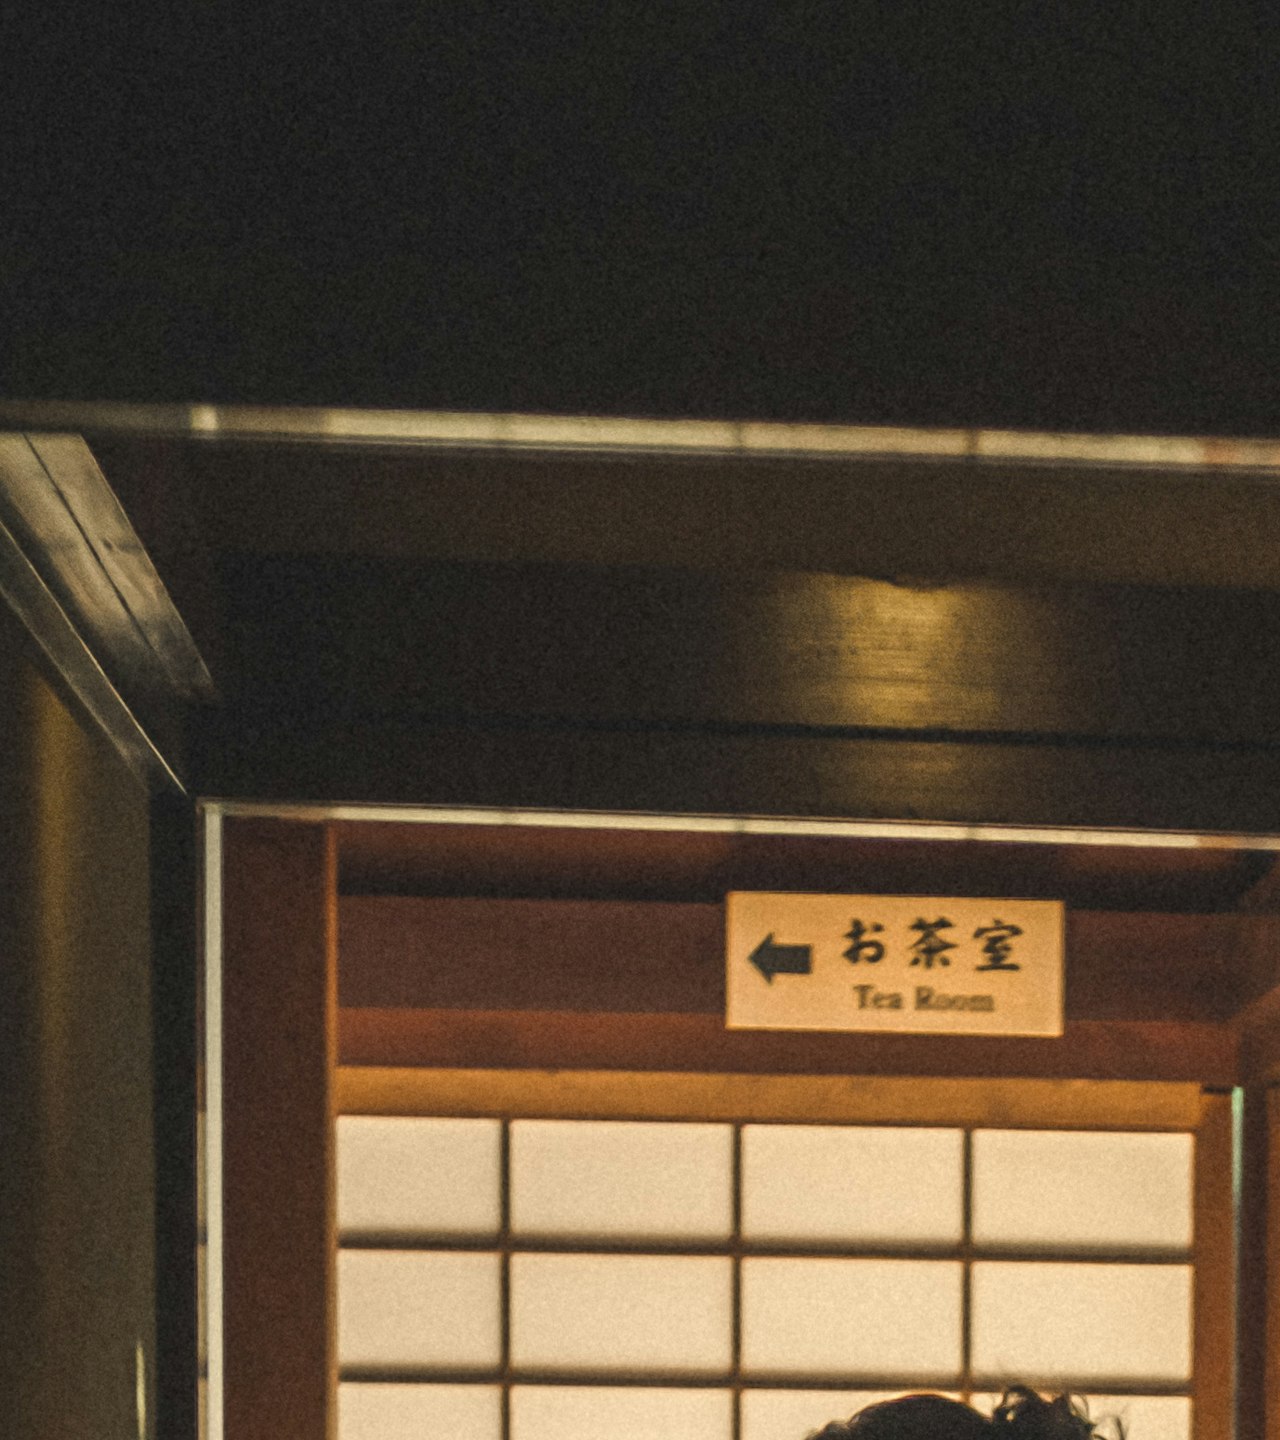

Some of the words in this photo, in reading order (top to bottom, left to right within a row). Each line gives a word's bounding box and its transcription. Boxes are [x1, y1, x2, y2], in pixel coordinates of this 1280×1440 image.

[842, 916, 1023, 972] お茶室
[853, 984, 904, 1010] Tea
[914, 985, 995, 1011] Room
